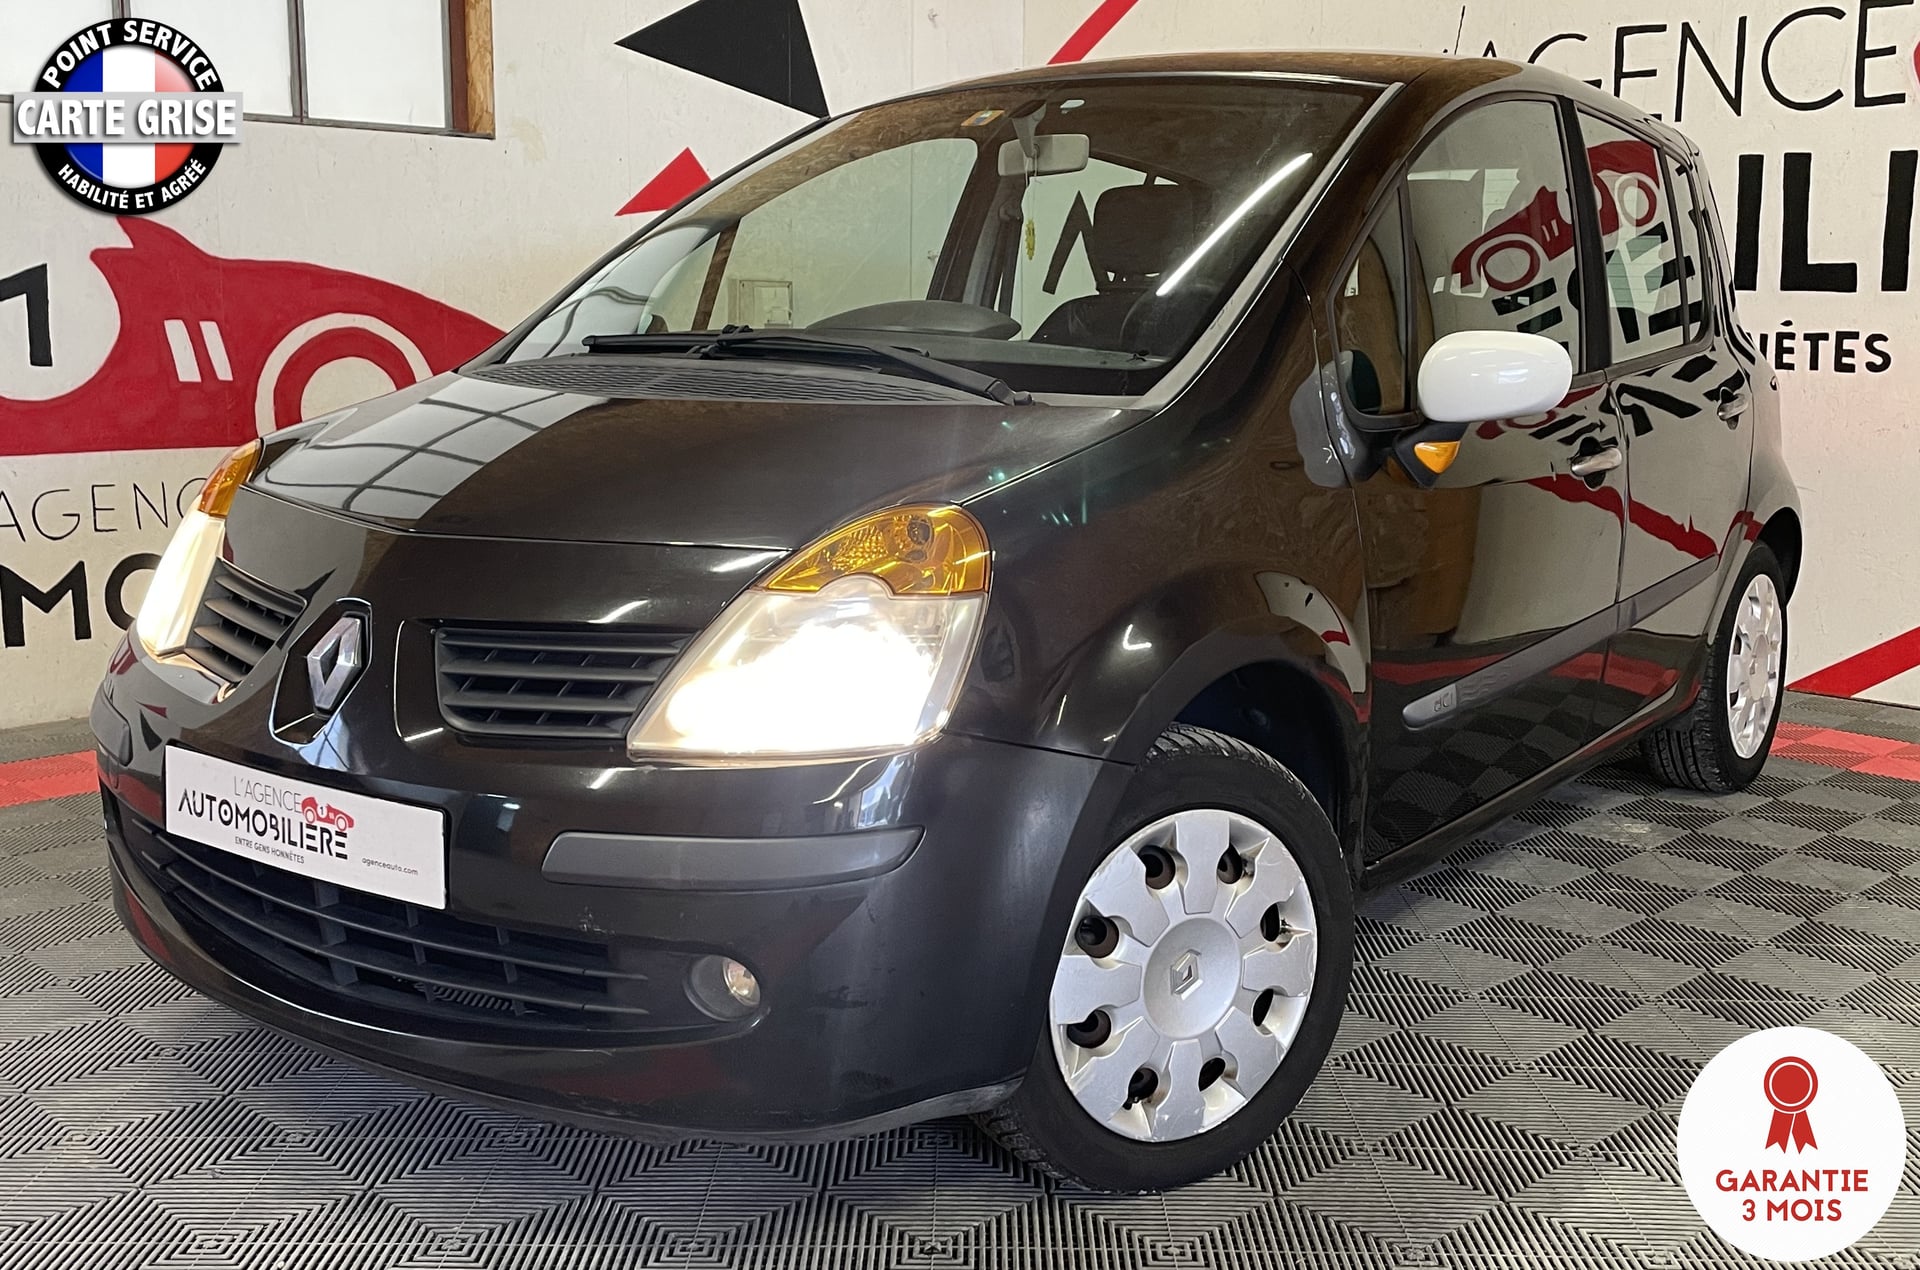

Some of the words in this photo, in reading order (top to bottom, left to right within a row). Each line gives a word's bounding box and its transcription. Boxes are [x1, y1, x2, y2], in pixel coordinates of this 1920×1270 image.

[0, 263, 53, 367] 1
[233, 776, 302, 813] L'AGENCE
[235, 836, 253, 849] ENTRE
[253, 842, 271, 854] GENS
[361, 857, 419, 876] agenceauto.com
